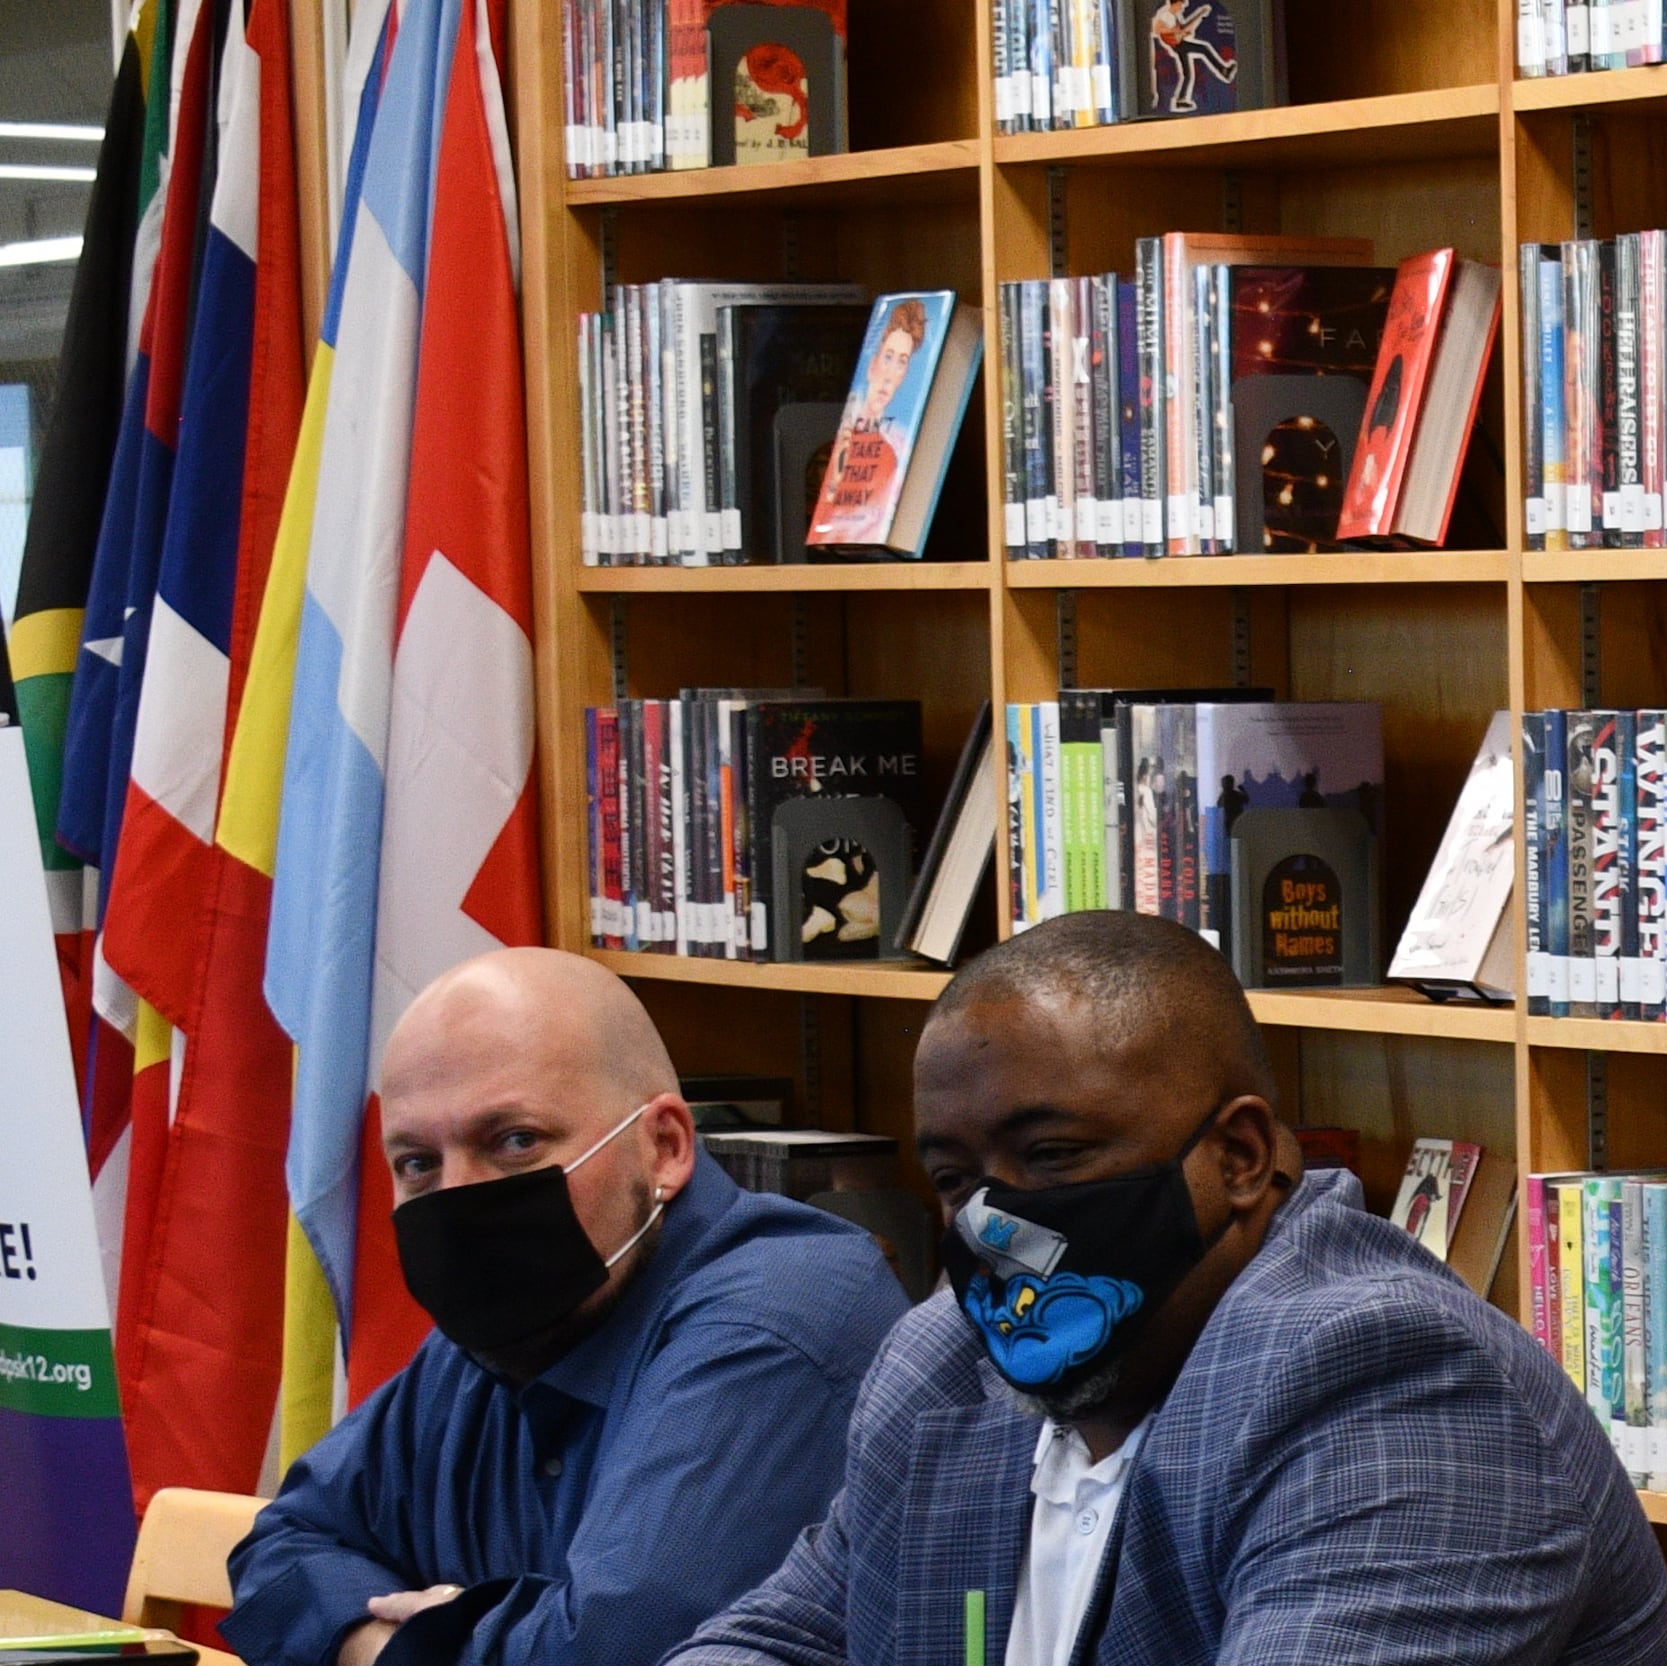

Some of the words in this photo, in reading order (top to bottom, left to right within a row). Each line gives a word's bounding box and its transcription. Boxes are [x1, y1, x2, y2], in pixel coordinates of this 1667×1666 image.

[851, 443, 883, 458] TAKE
[843, 465, 878, 482] THAT
[771, 756, 868, 779] BREAK
[878, 754, 918, 776] ME
[1526, 811, 1538, 841] THE
[1280, 878, 1327, 903] Boys
[1527, 846, 1539, 923] MARBURY
[1268, 905, 1341, 932] without
[1274, 932, 1335, 957] Names
